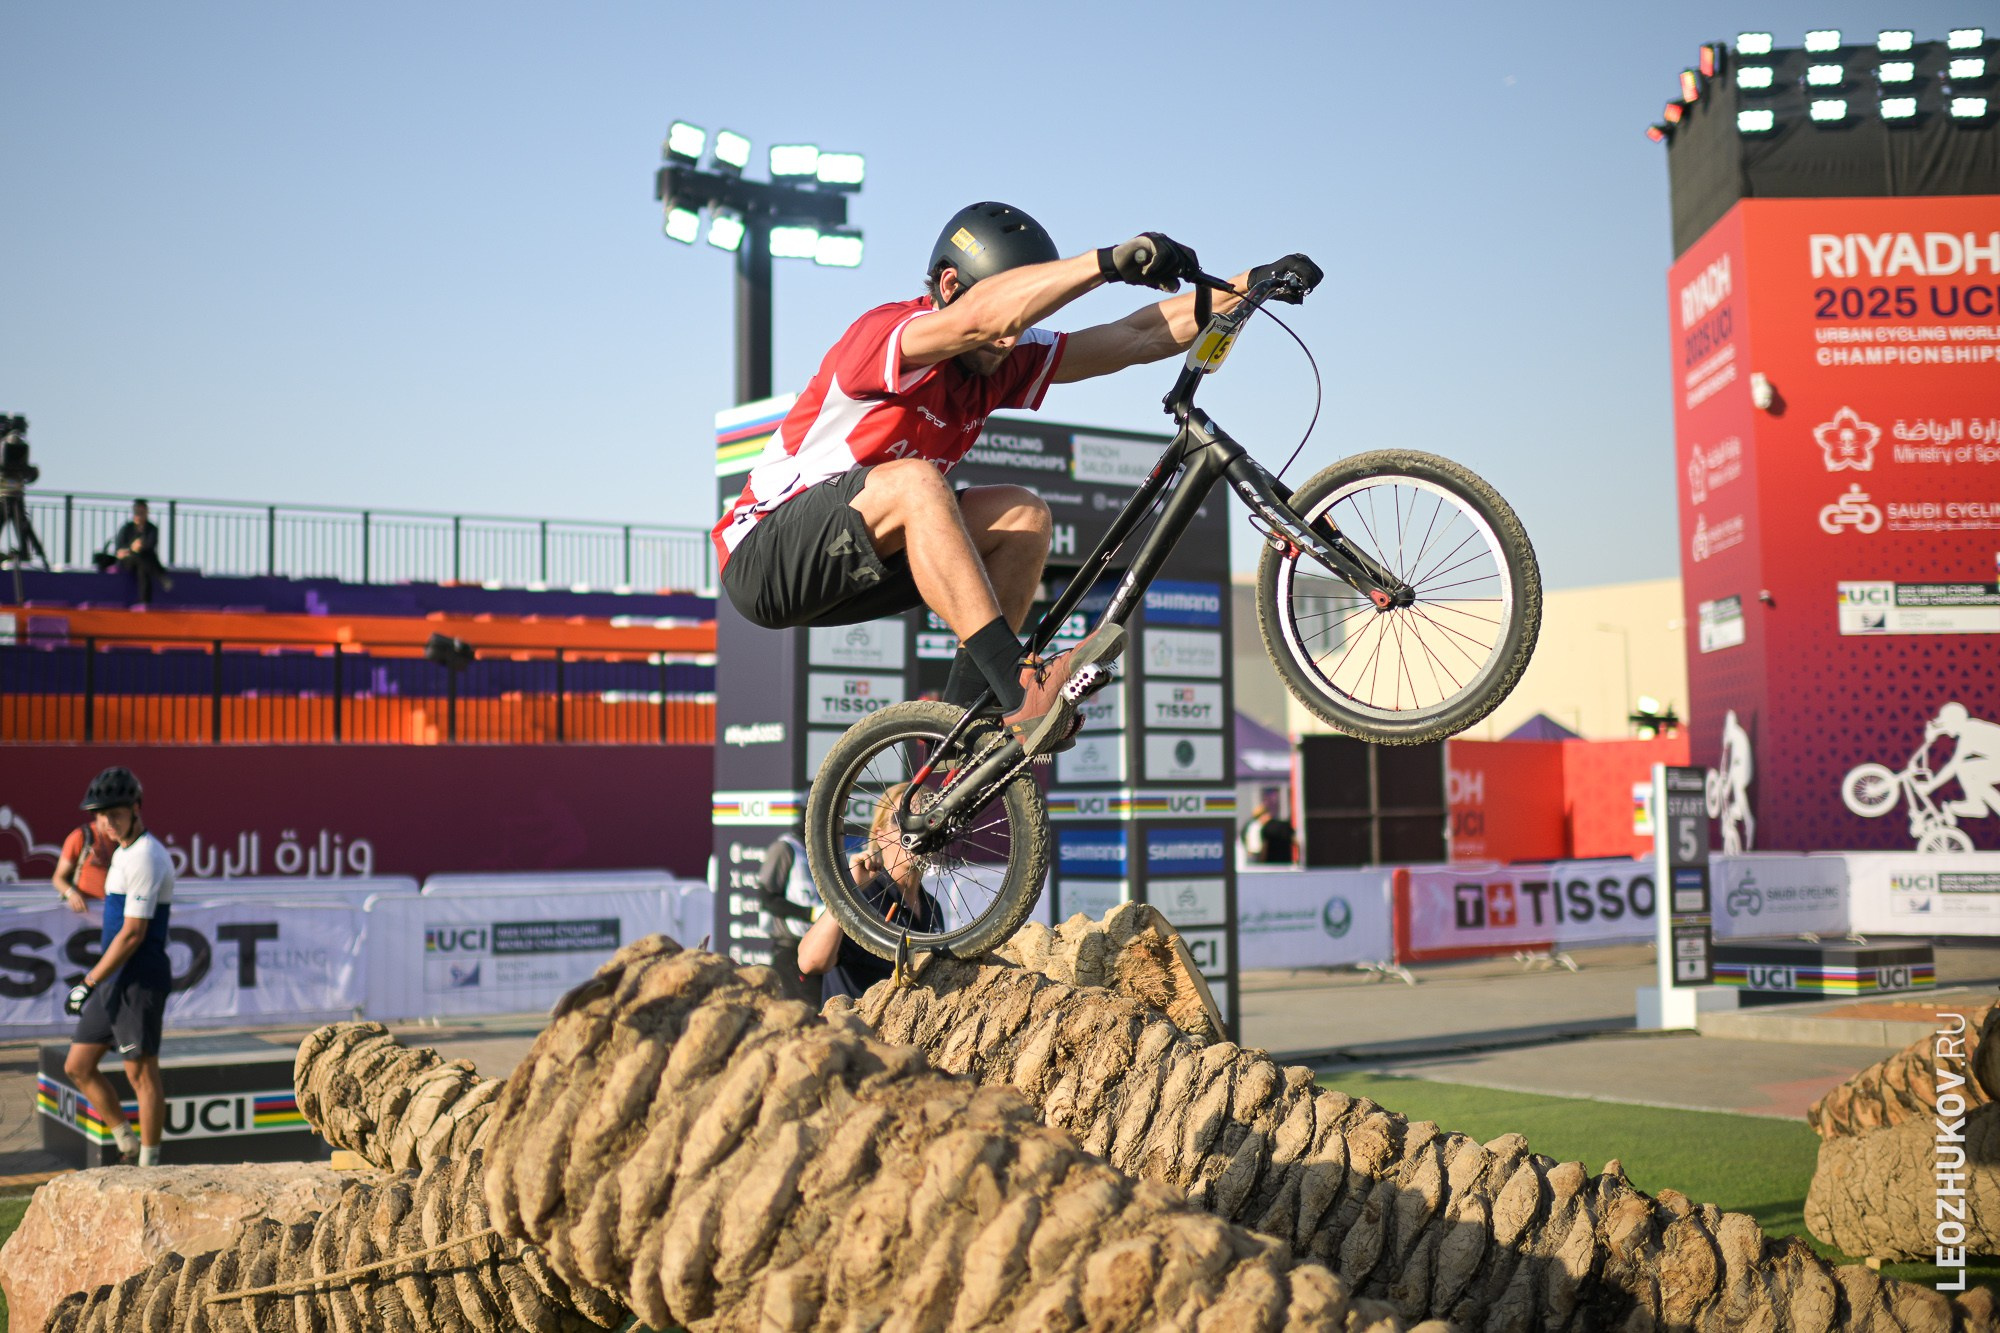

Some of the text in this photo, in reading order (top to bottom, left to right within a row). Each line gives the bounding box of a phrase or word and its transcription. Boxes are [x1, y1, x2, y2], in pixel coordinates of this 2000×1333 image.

[1809, 232, 2000, 278] RIYADH
[1814, 286, 1917, 320] 2025
[1815, 325, 2000, 343] URBAN CYCLING WORL
[990, 435, 1044, 453] CYCLING
[1894, 444, 1951, 465] Ministry
[1955, 446, 1973, 463] of
[1887, 502, 1941, 519] SAUDI
[1146, 592, 1219, 613] SHIMANO
[1849, 589, 1889, 605] UCI
[824, 697, 889, 712] TISSOT
[1156, 704, 1212, 718] TISSOT
[740, 801, 765, 817] UCI
[1077, 799, 1105, 814] UCI
[1169, 797, 1200, 812] UCI
[1668, 799, 1703, 816] START
[1678, 817, 1699, 862] 5
[1060, 845, 1126, 860] SHIMANO
[1149, 843, 1223, 860] SHIMANO
[1899, 875, 1935, 891] UCI
[437, 928, 487, 952] UCI
[1194, 940, 1218, 967] CI
[1749, 968, 1793, 990] UCI
[1877, 967, 1911, 988] UCI
[58, 1086, 77, 1123] UCI
[162, 1097, 246, 1135] UCI
